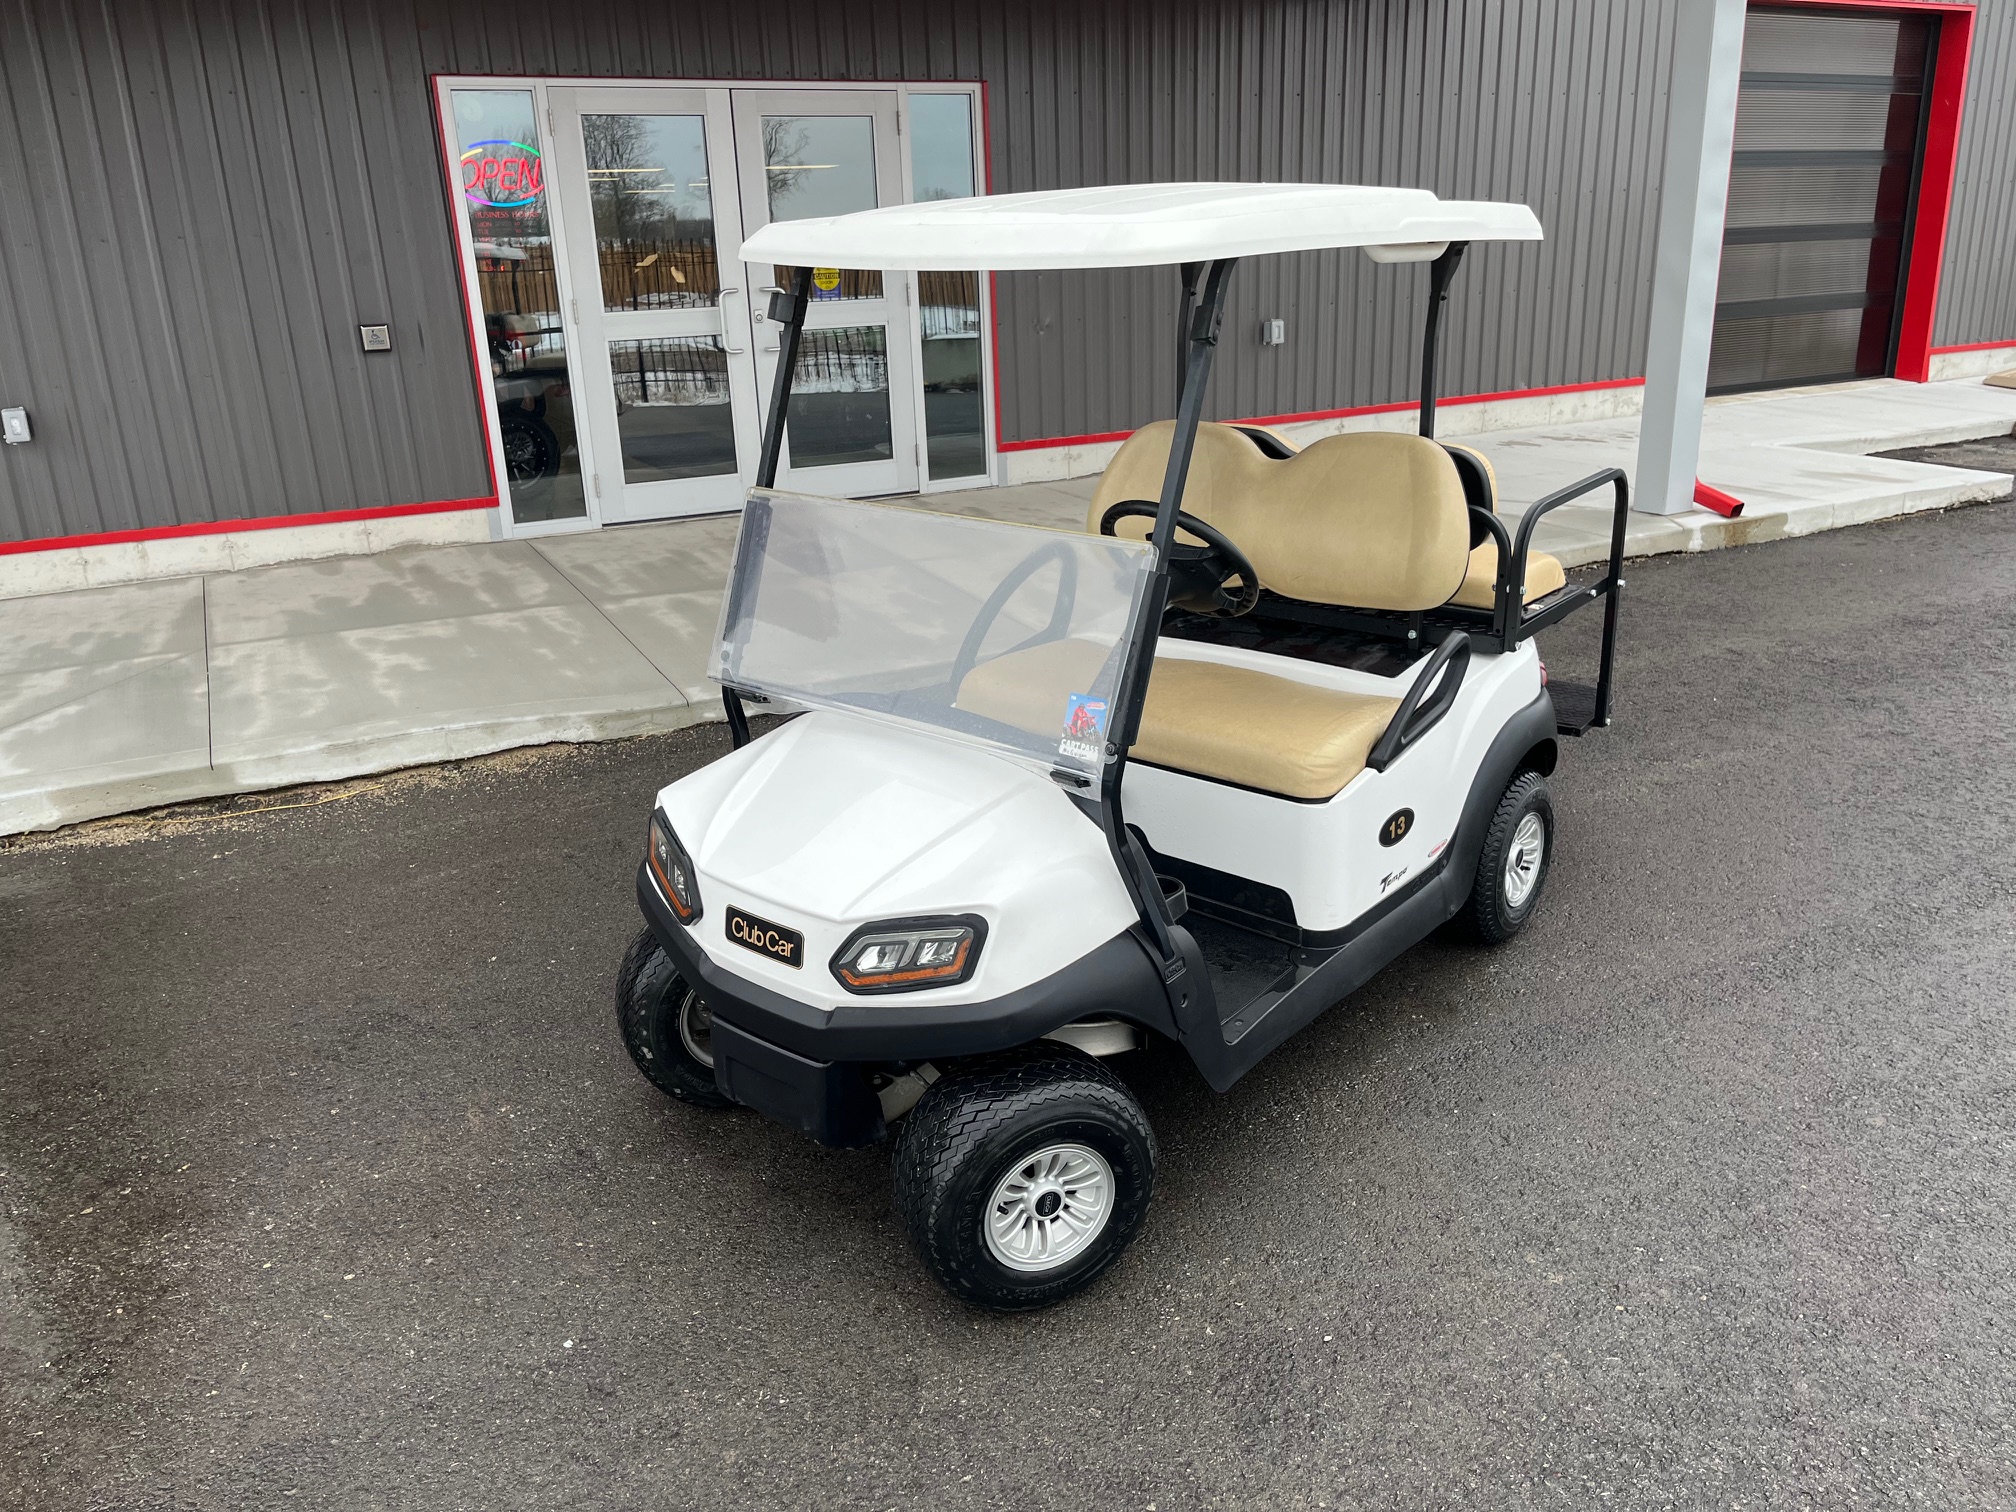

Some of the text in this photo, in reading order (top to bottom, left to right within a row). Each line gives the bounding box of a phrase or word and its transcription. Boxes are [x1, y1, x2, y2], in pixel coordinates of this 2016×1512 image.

[461, 157, 541, 190] OPEN
[475, 211, 539, 219] BUSINESS HOURS
[1061, 739, 1099, 753] CART PASS
[1390, 816, 1406, 839] 13
[1379, 866, 1408, 894] Tempo
[732, 917, 794, 957] Club Car
